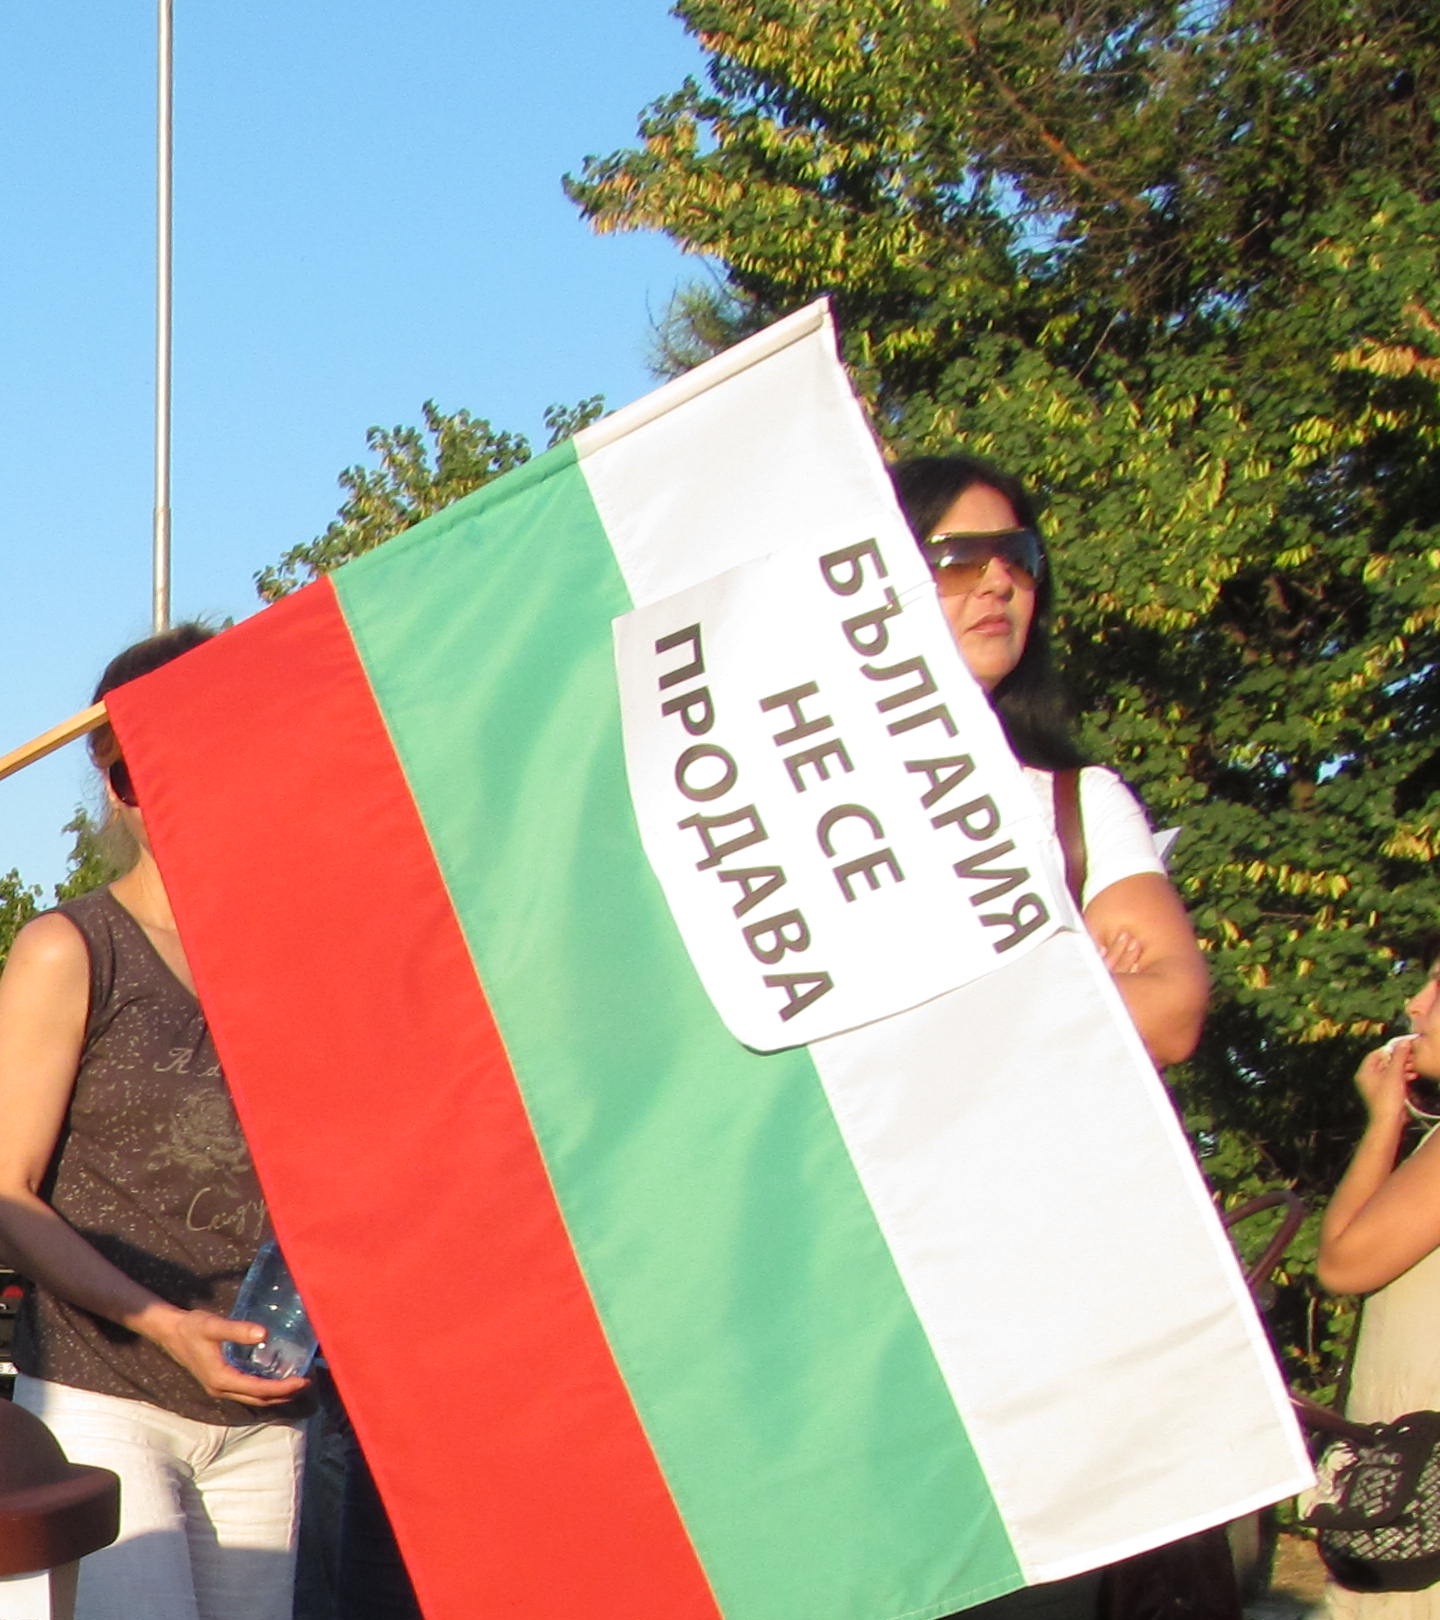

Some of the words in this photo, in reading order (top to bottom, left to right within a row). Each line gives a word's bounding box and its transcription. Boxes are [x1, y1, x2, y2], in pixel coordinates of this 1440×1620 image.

[654, 622, 834, 1022] ПРОДАВА
[759, 680, 855, 793] НЕ
[816, 803, 905, 903] СЕ
[818, 537, 1051, 954] БЪЛГАРИЯ
